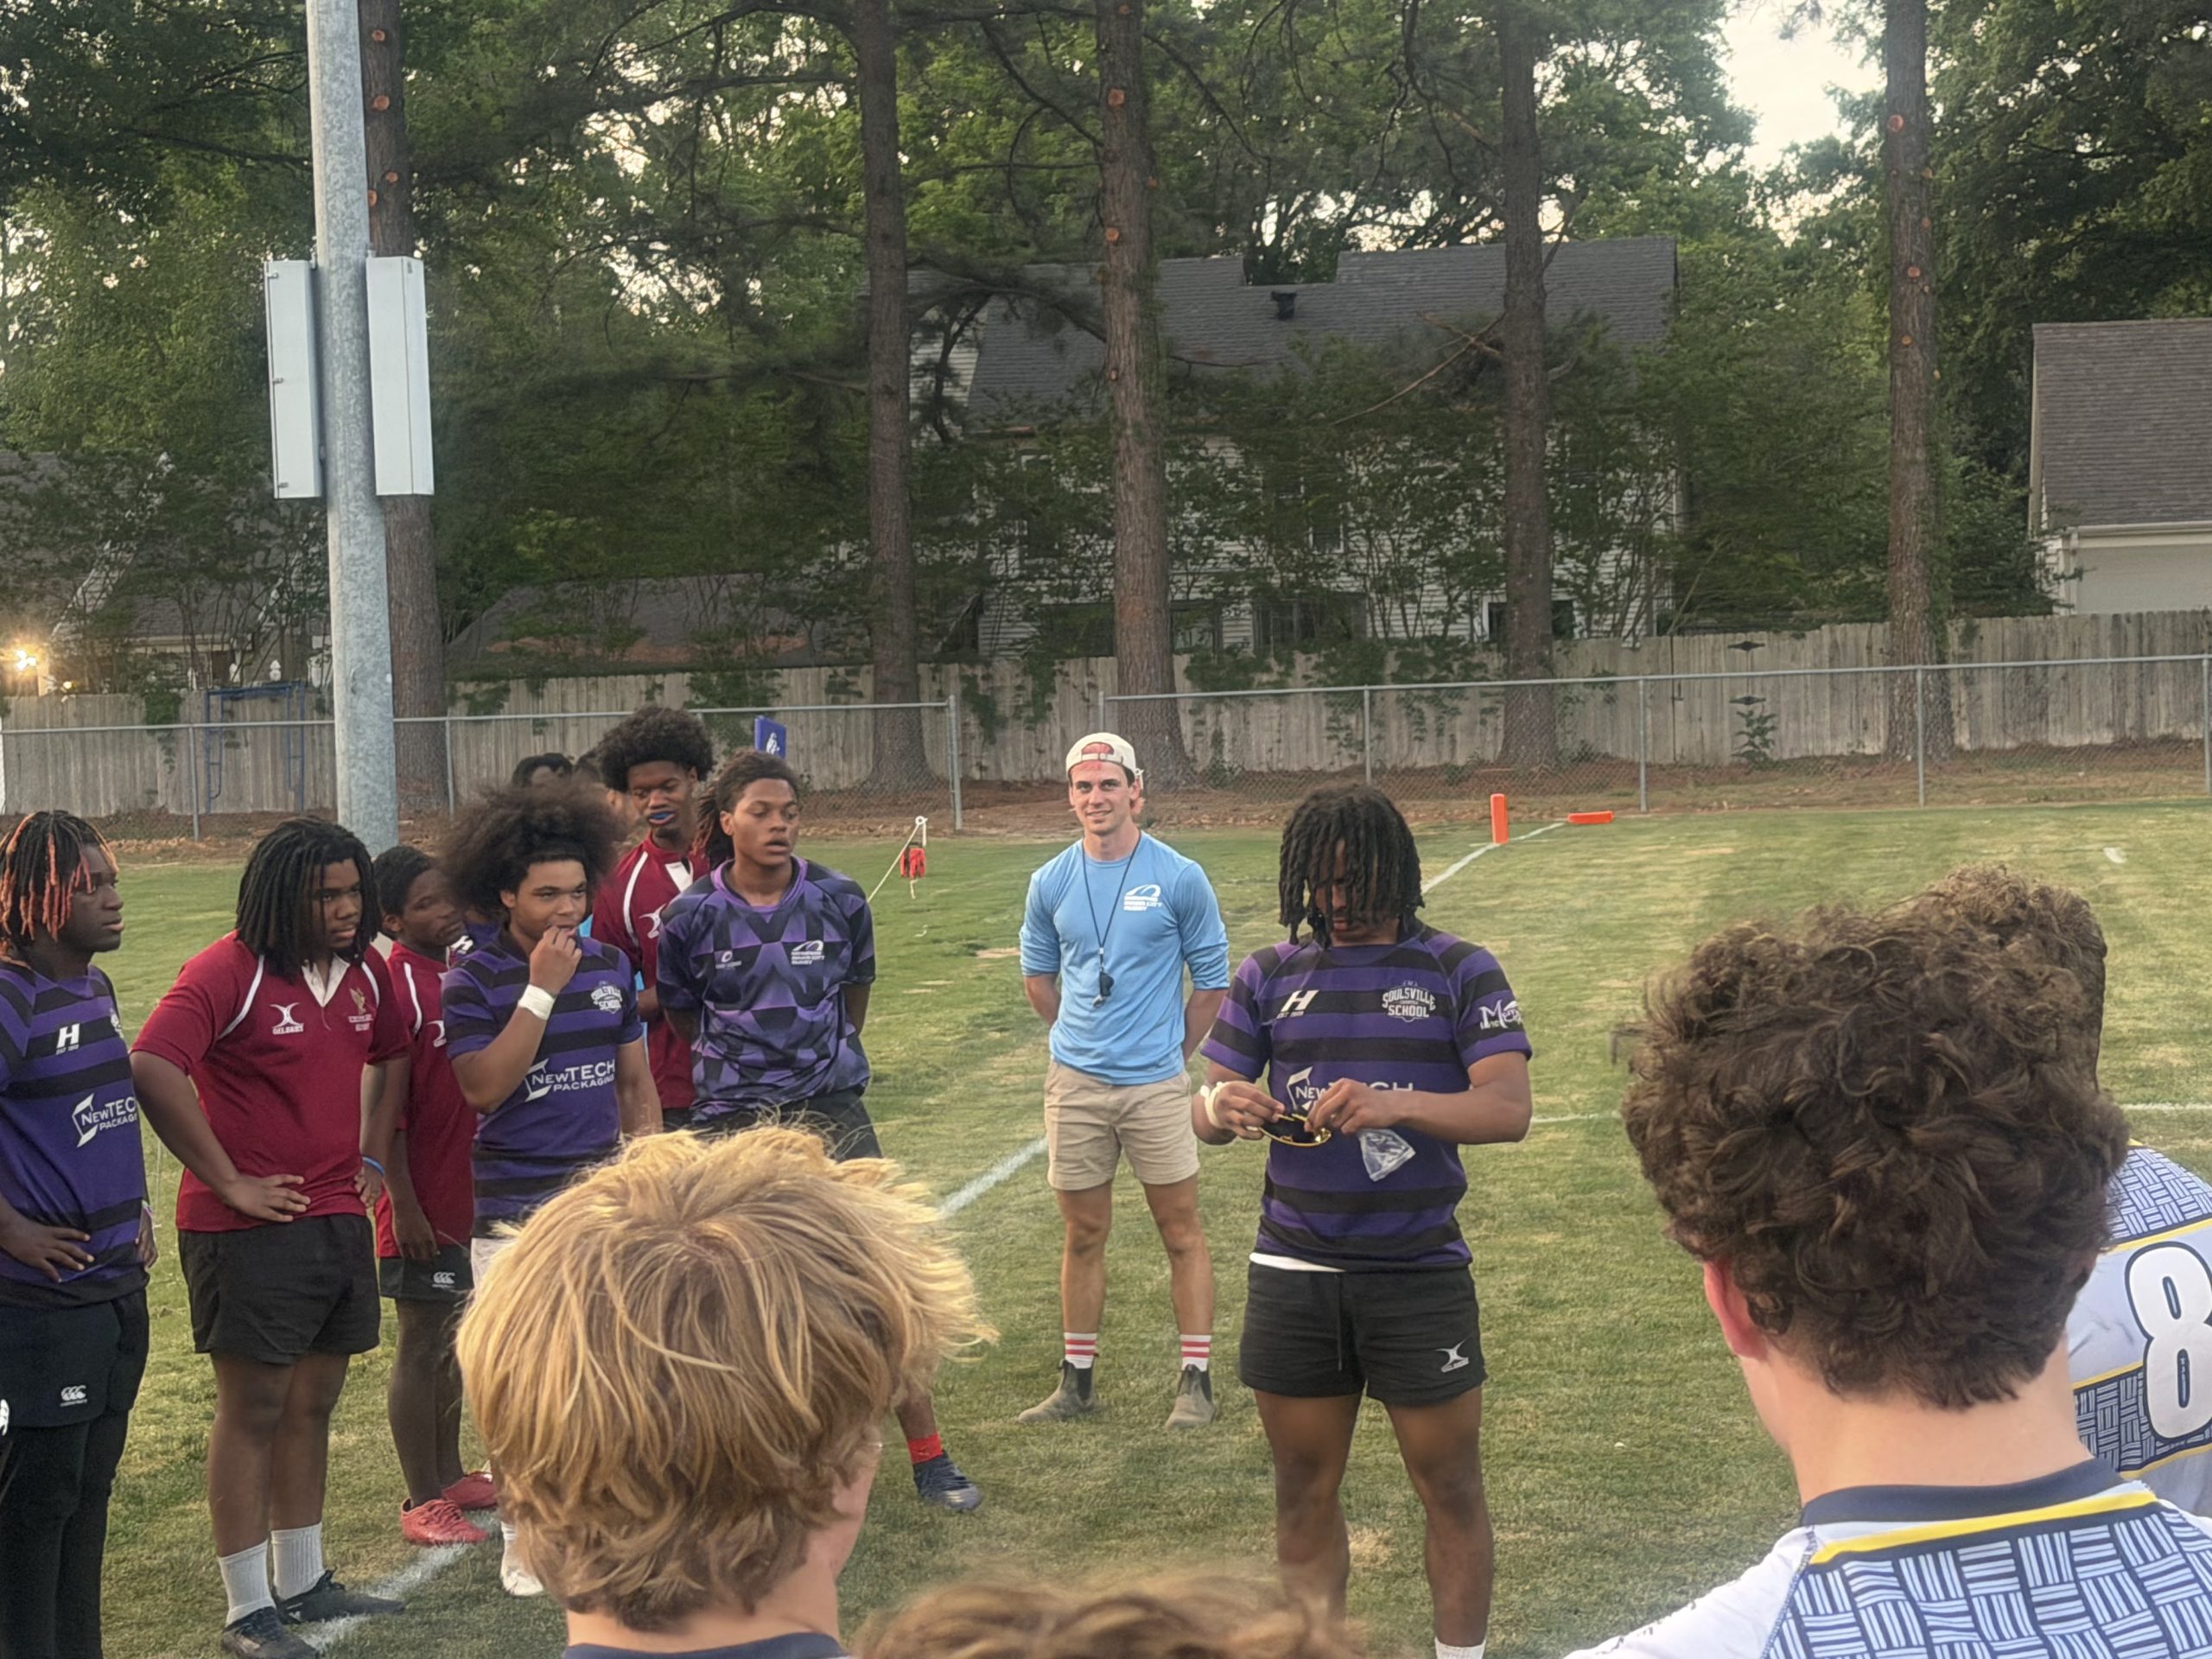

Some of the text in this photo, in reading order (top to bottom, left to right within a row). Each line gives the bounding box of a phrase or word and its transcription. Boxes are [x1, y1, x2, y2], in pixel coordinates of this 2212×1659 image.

[1281, 989, 1319, 1012] H
[1382, 987, 1436, 1011] SOULSVILLE
[1388, 1004, 1430, 1018] SCHOOL
[56, 1023, 80, 1048] H
[2125, 1241, 2212, 1441] 8
